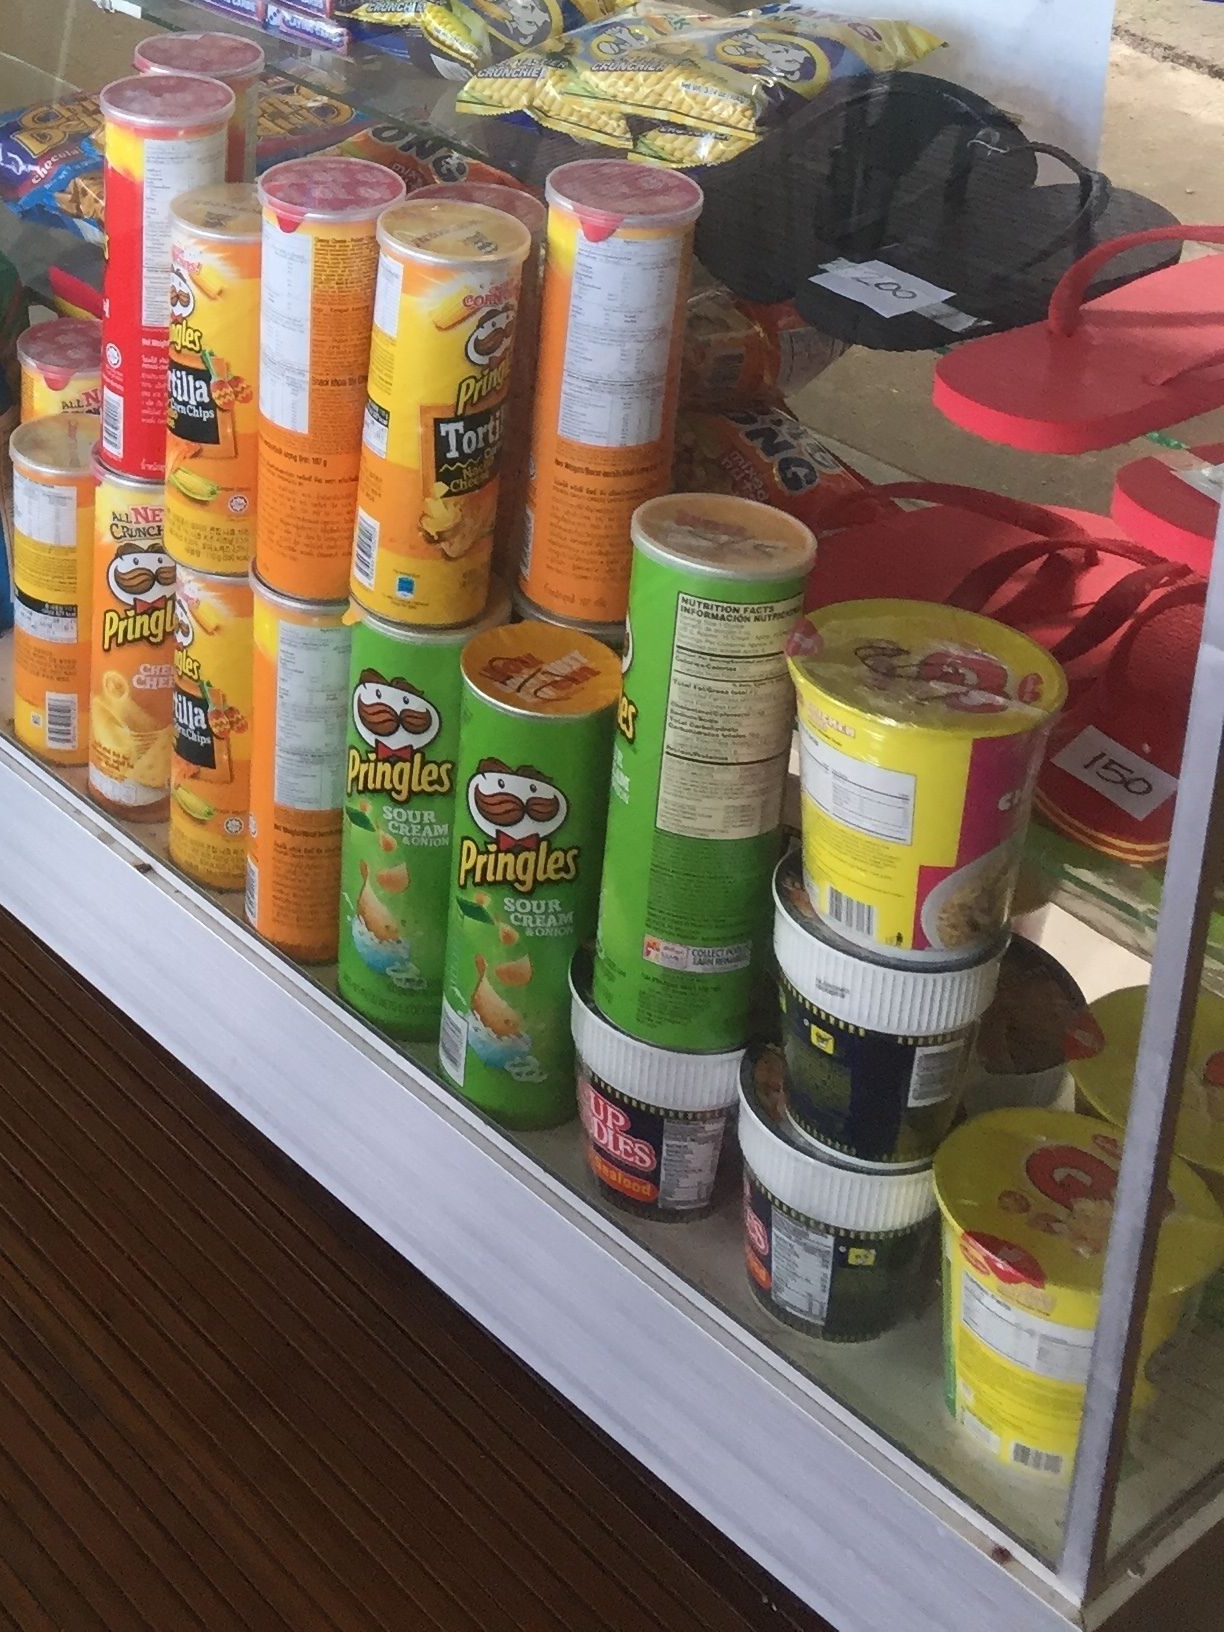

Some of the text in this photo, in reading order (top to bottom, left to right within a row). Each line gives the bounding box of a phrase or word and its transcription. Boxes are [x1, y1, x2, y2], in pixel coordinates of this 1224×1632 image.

[371, 124, 468, 184] ONG
[171, 321, 203, 352] gles
[168, 367, 210, 406] tilla
[456, 368, 510, 416] Pring
[187, 405, 215, 422] Chips
[439, 411, 502, 459] Torti
[112, 506, 164, 524] ALL NE
[680, 596, 775, 614] NUTRITION FACTS
[103, 600, 176, 652] Pringl
[139, 663, 175, 677] CHE
[174, 649, 200, 680] gles
[173, 691, 207, 730] tilla
[186, 728, 212, 747] Chips
[346, 746, 453, 803] Pringles
[1083, 751, 1154, 796] 150
[381, 805, 437, 824] SOUR
[387, 821, 449, 838] CREAM
[411, 836, 450, 847] ONION
[459, 839, 579, 893] Pringles
[503, 896, 562, 914] SOUR
[509, 911, 574, 928] CREAM
[533, 926, 574, 937] ONION
[589, 1089, 627, 1129] UP
[592, 1117, 656, 1168] DLES
